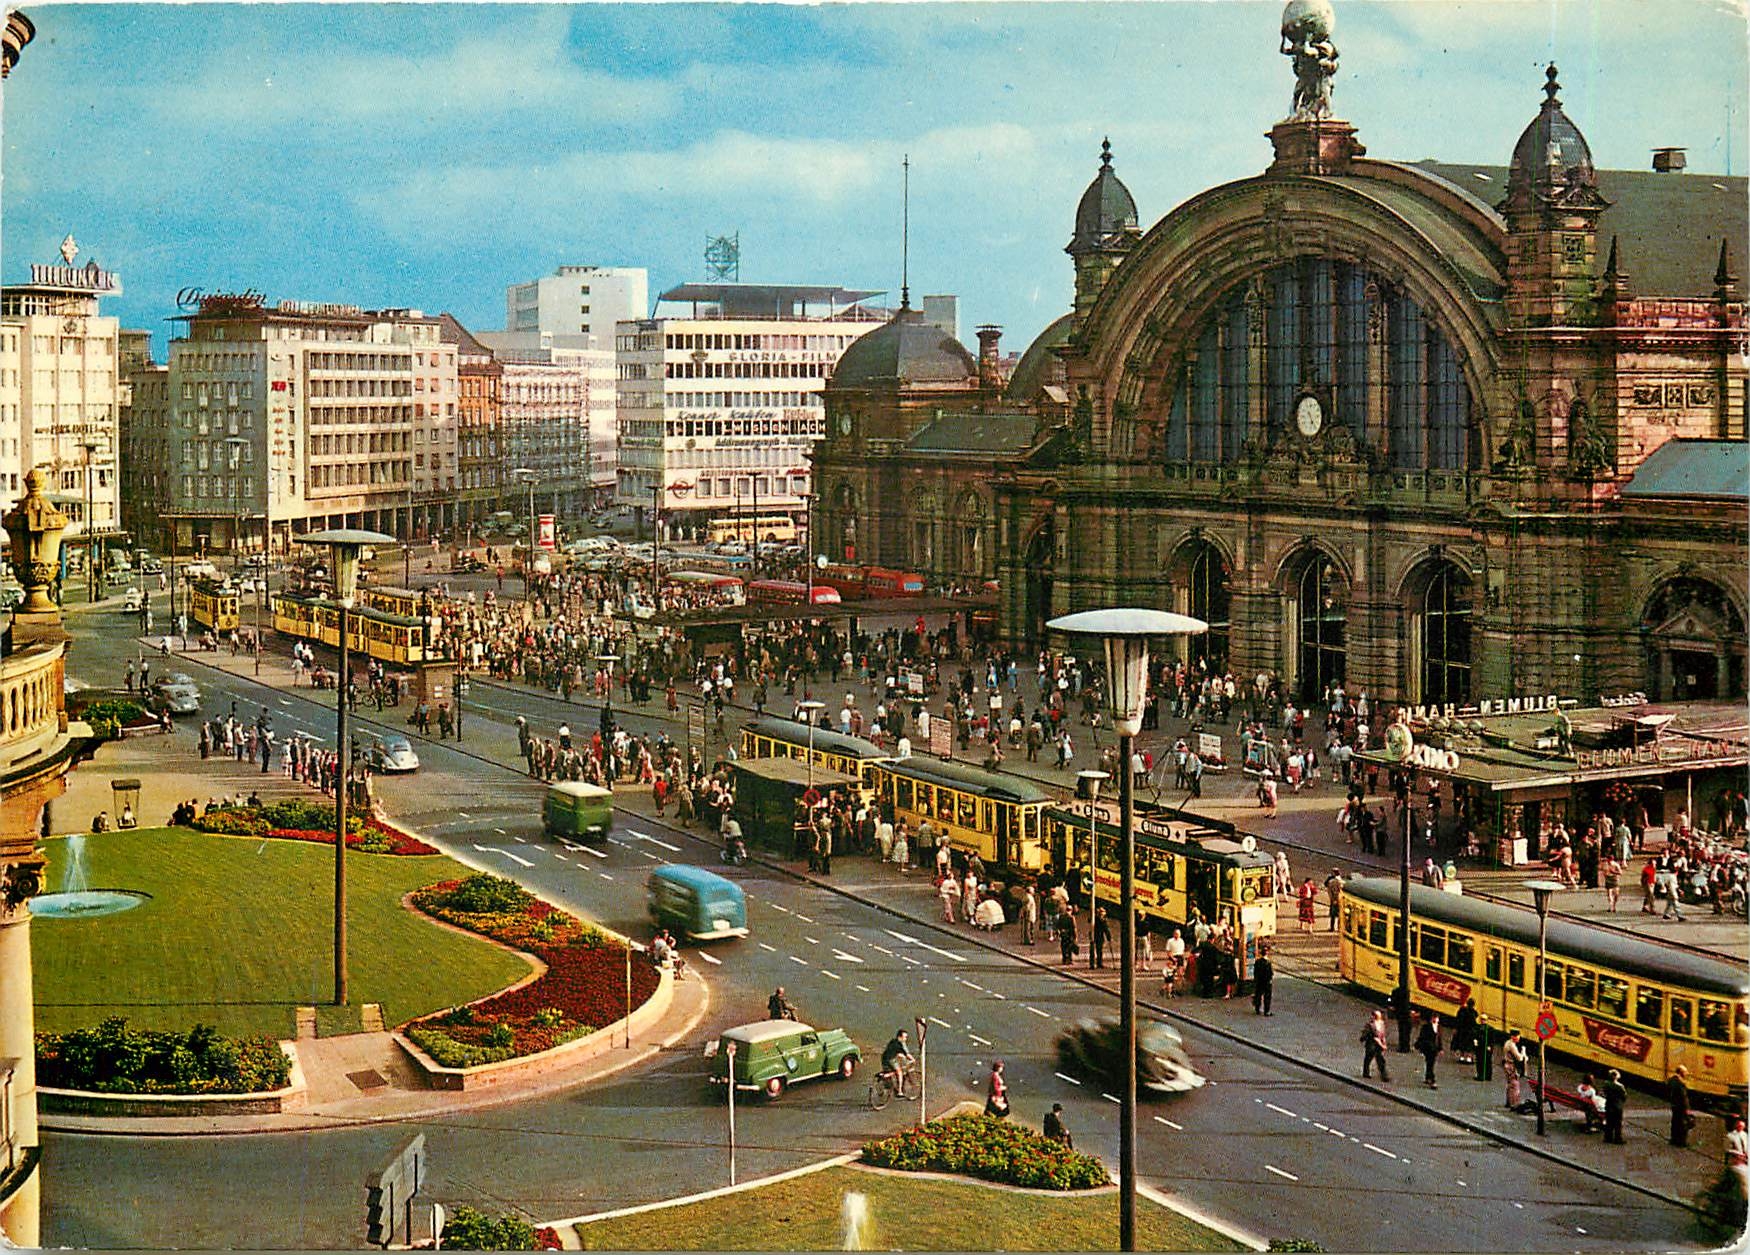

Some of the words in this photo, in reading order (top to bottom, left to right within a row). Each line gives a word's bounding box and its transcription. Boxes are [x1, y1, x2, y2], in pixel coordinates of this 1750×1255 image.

[176, 286, 267, 311] Dujardin
[1577, 742, 1662, 769] BLUMEN
[1142, 820, 1169, 838] Bluna
